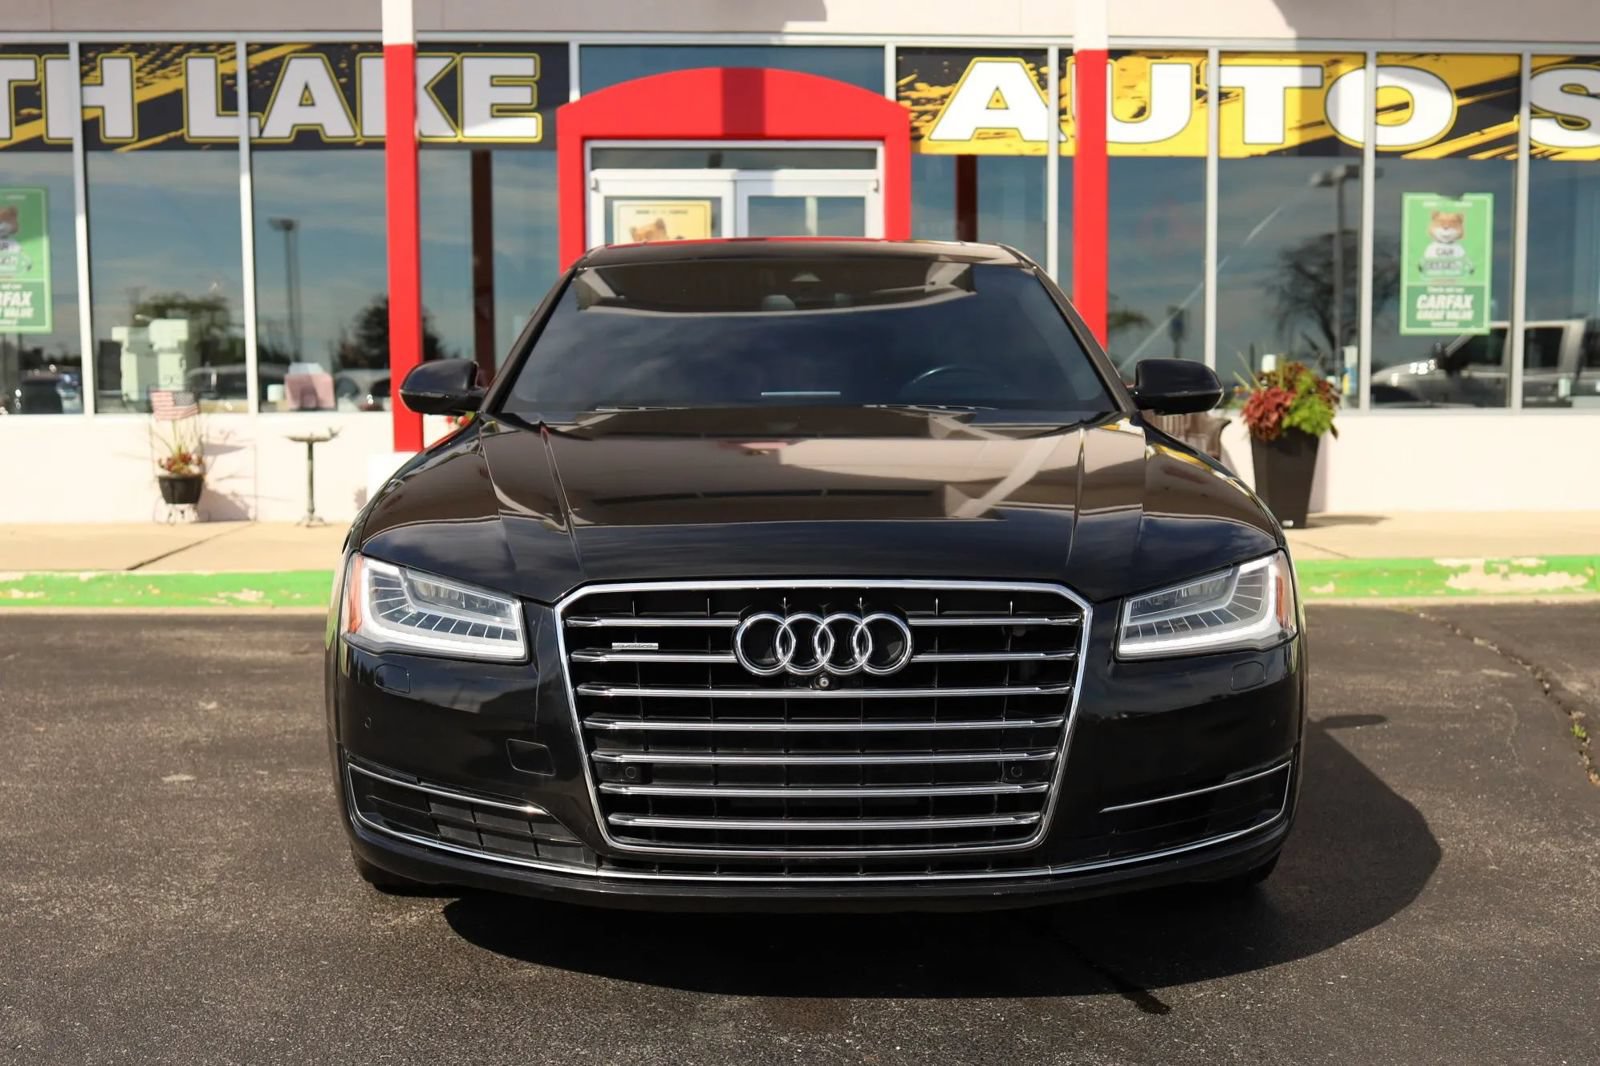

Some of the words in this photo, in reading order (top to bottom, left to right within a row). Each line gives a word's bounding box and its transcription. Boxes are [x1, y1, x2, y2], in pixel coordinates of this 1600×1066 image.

[183, 53, 542, 143] LAKE
[928, 57, 1458, 151] AUTO
[1416, 294, 1474, 309] CARFAX
